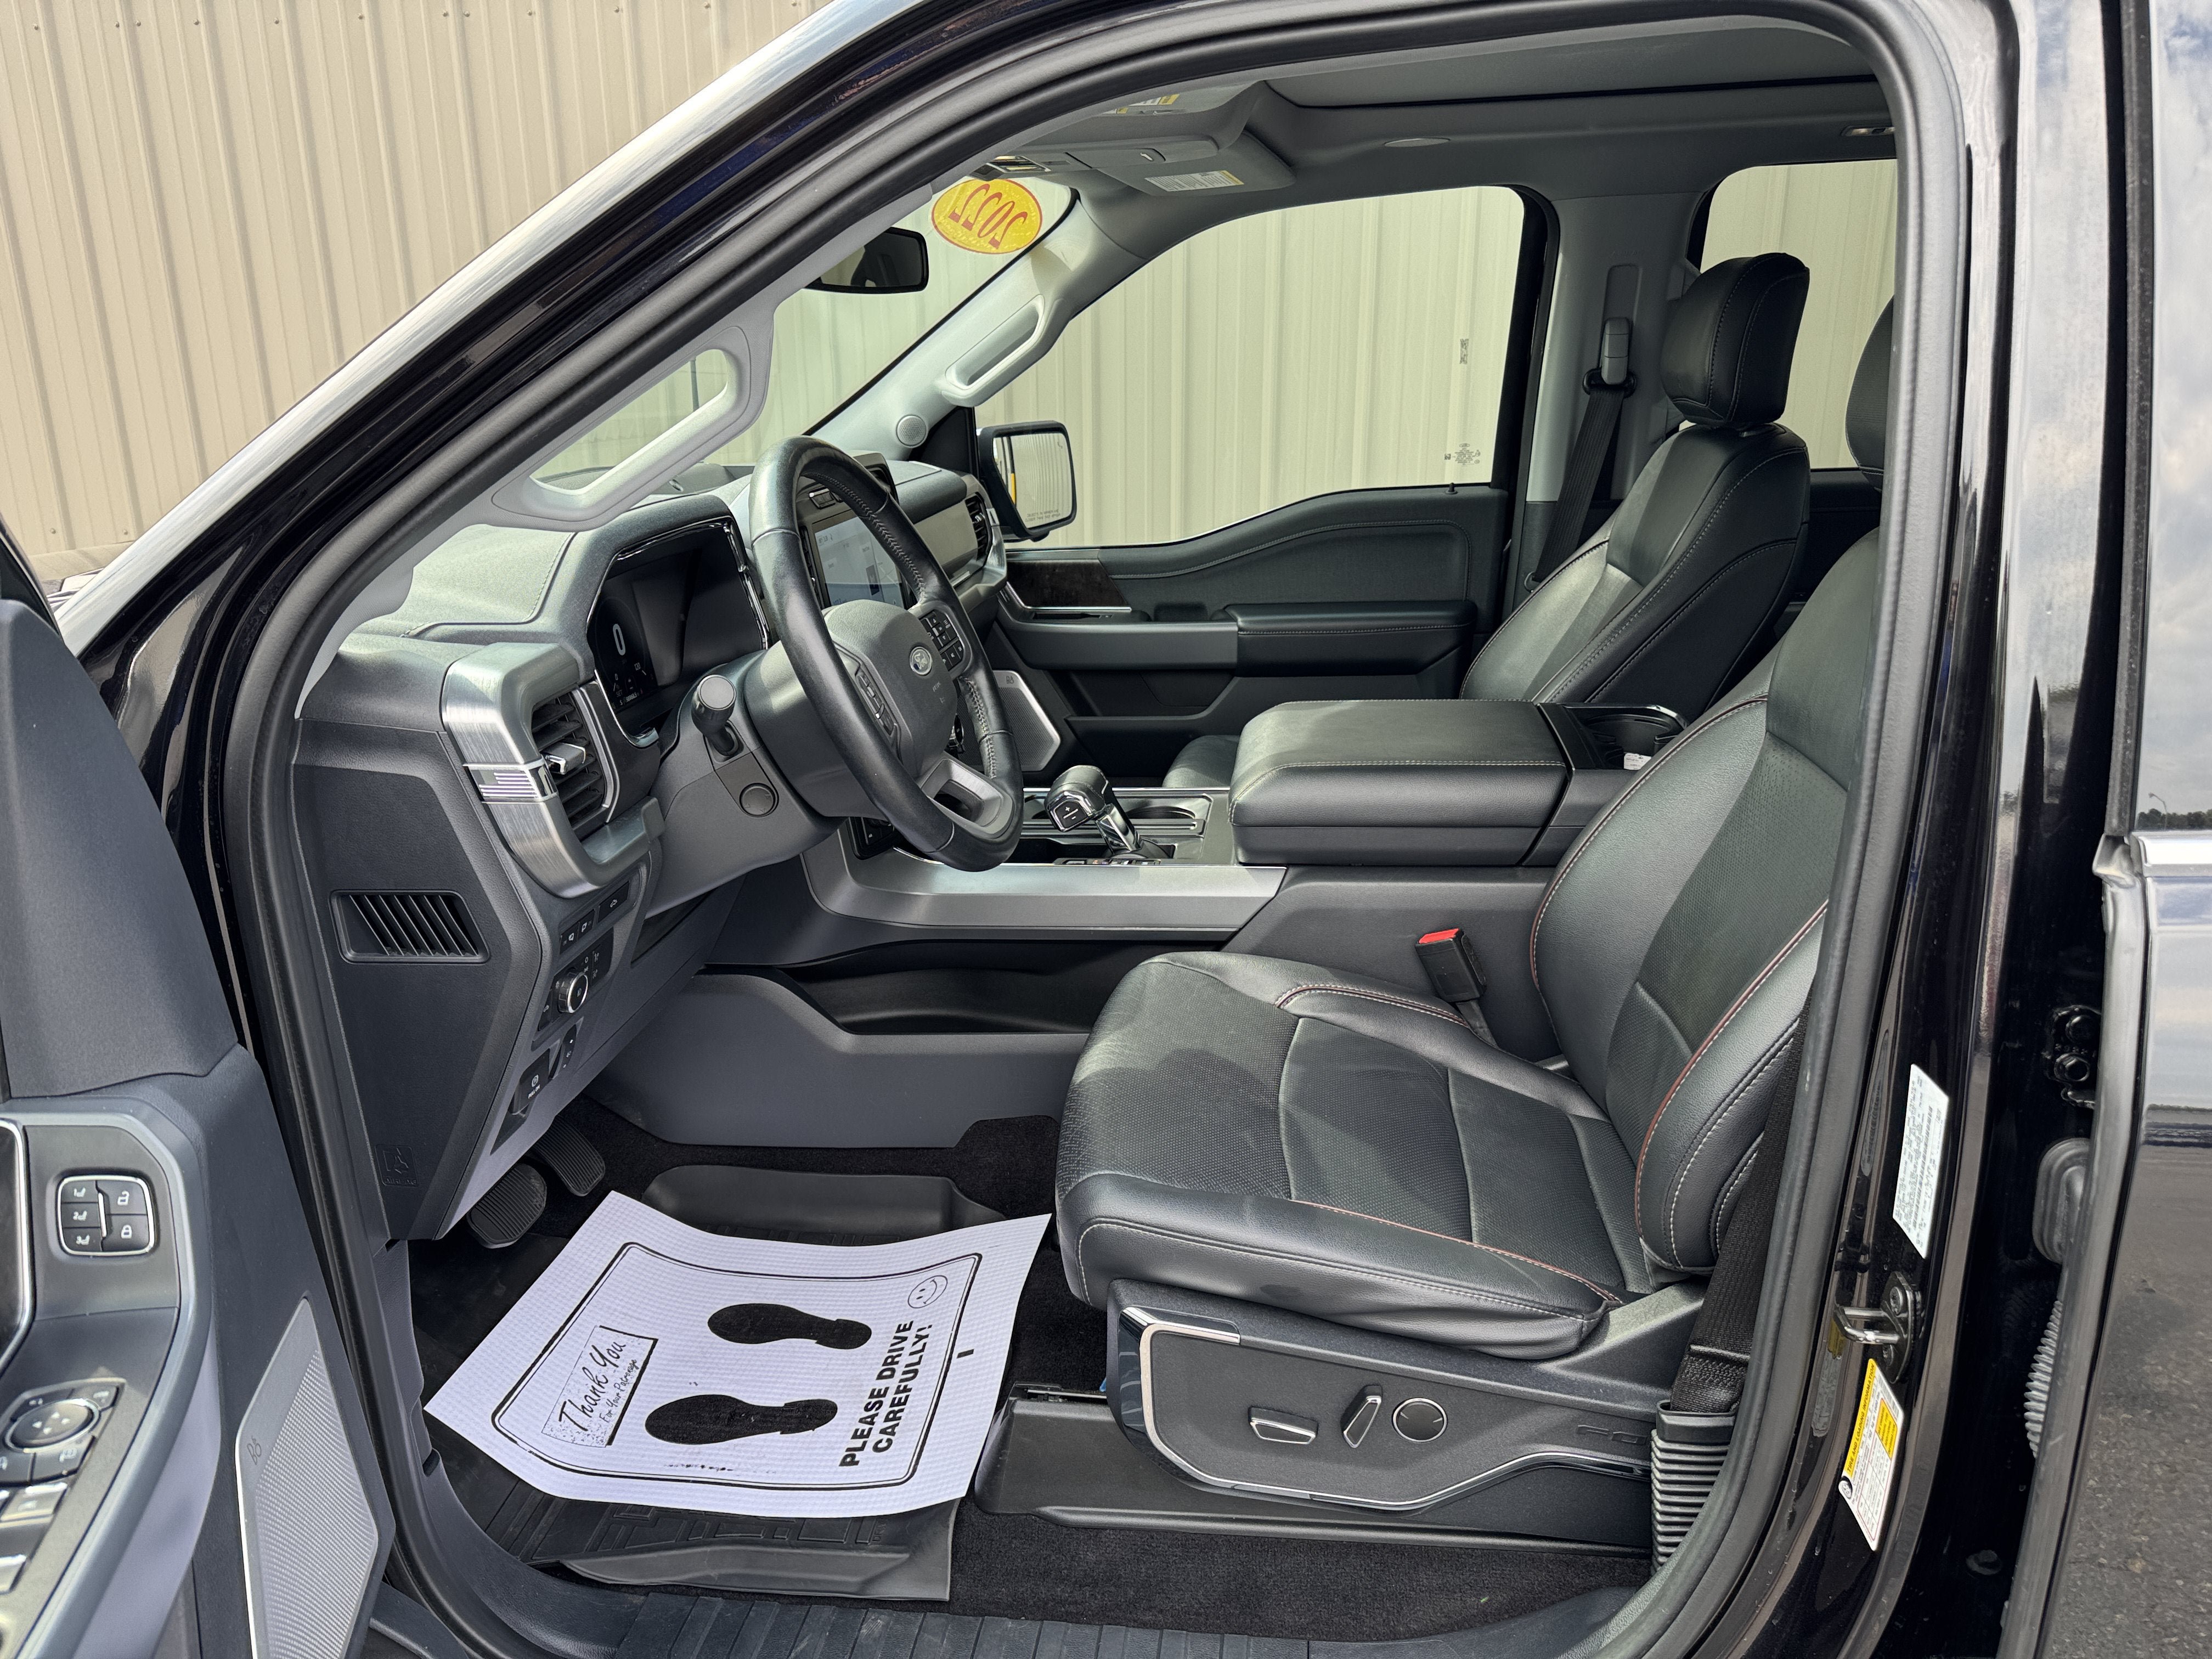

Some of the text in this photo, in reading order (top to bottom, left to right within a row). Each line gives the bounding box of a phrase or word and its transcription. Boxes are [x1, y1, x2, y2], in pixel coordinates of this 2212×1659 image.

[613, 624, 625, 656] 0
[72, 1211, 79, 1221] 2
[558, 1342, 626, 1431] Thank You
[599, 1359, 640, 1423] For Your Patronage
[838, 1321, 913, 1466] PLEASE DRIVE
[872, 1324, 933, 1453] CAREFULLY!
[1855, 1412, 1865, 1441] LOADING
[1863, 1363, 1875, 1410] INFORMATION
